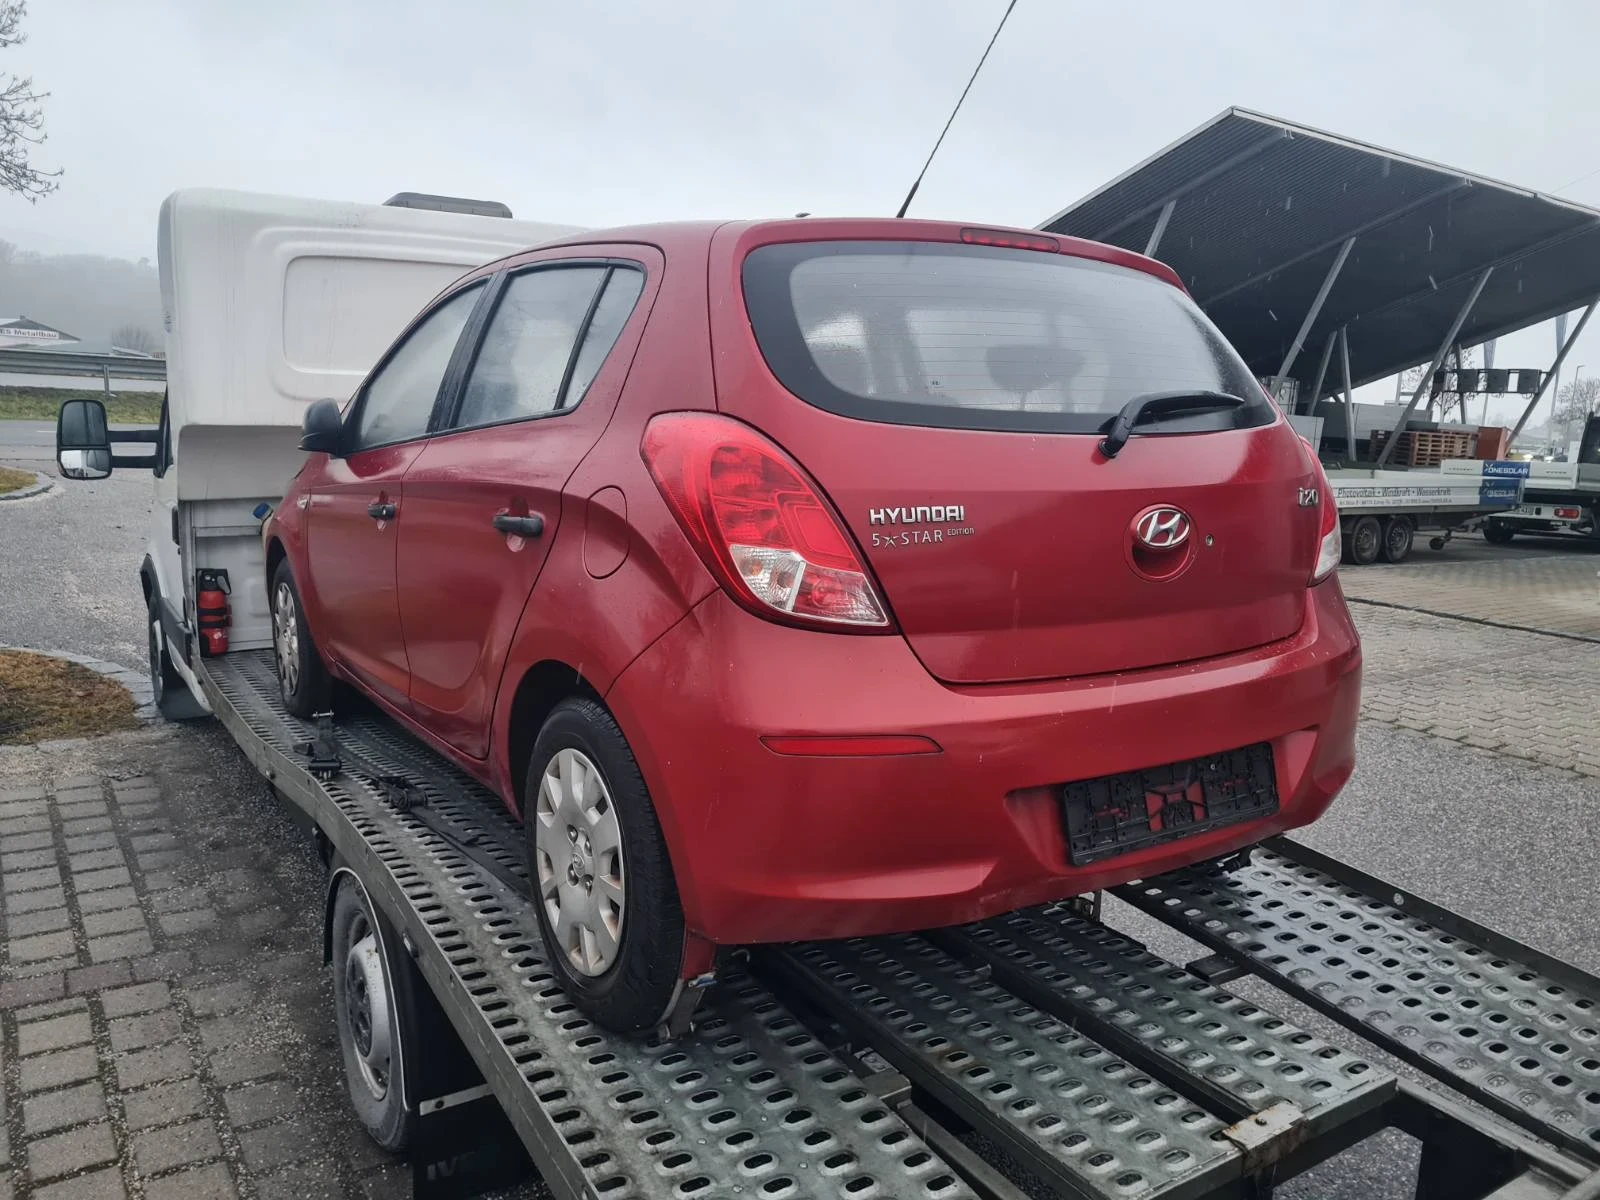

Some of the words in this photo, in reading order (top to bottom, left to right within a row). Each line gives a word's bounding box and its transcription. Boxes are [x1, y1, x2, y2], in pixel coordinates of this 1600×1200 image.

[14, 329, 57, 338] Metallbau
[1299, 487, 1319, 506] i20
[1382, 487, 1411, 497] Windkraft
[1416, 487, 1452, 497] Wasserkraft
[869, 505, 965, 525] HYUNDAI
[947, 527, 975, 536] EDITION
